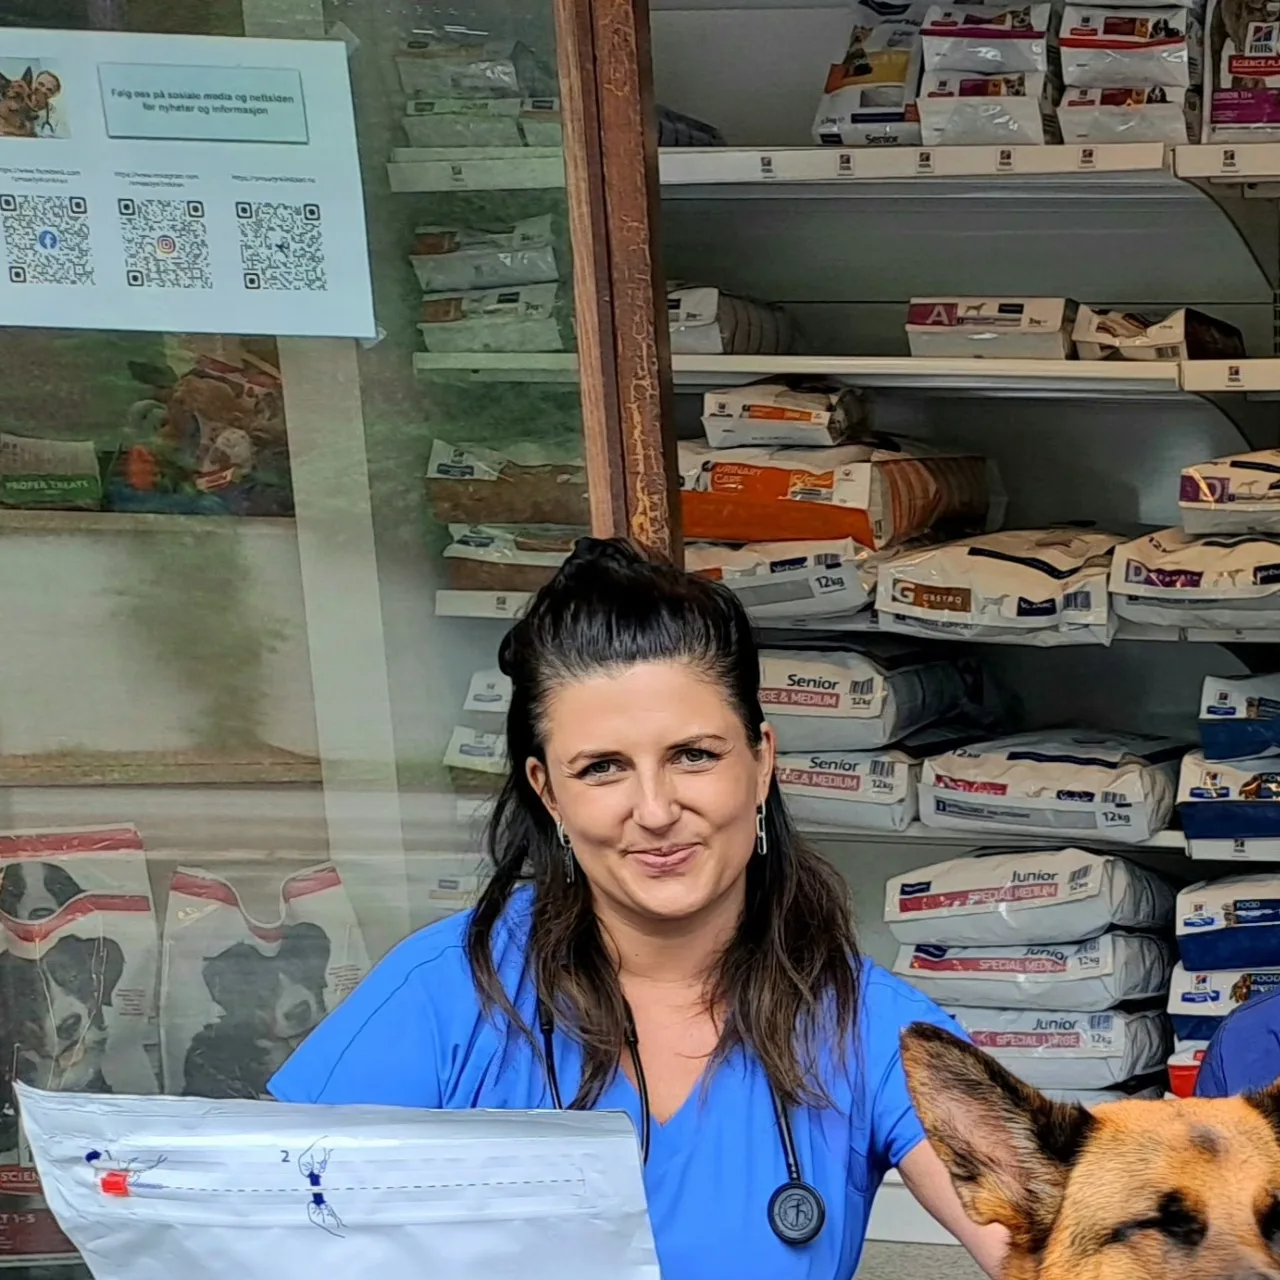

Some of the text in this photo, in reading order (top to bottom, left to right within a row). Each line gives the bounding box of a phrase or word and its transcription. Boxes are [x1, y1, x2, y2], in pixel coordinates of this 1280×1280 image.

[926, 305, 949, 325] A
[815, 574, 845, 588] 12kg
[787, 673, 840, 691] Senior
[791, 692, 837, 707] MEDIUM
[808, 756, 860, 773] Senior
[811, 774, 858, 789] MEDIUM
[1102, 811, 1131, 824] 12kg
[1010, 869, 1061, 885] Junior
[1014, 884, 1057, 899] MEDIUM
[978, 959, 1023, 971] SPECIAL
[1032, 1017, 1079, 1032] Junior
[995, 1033, 1039, 1046] SPECIAL
[280, 1149, 290, 1162] 2
[0, 1171, 40, 1183] SCIEN
